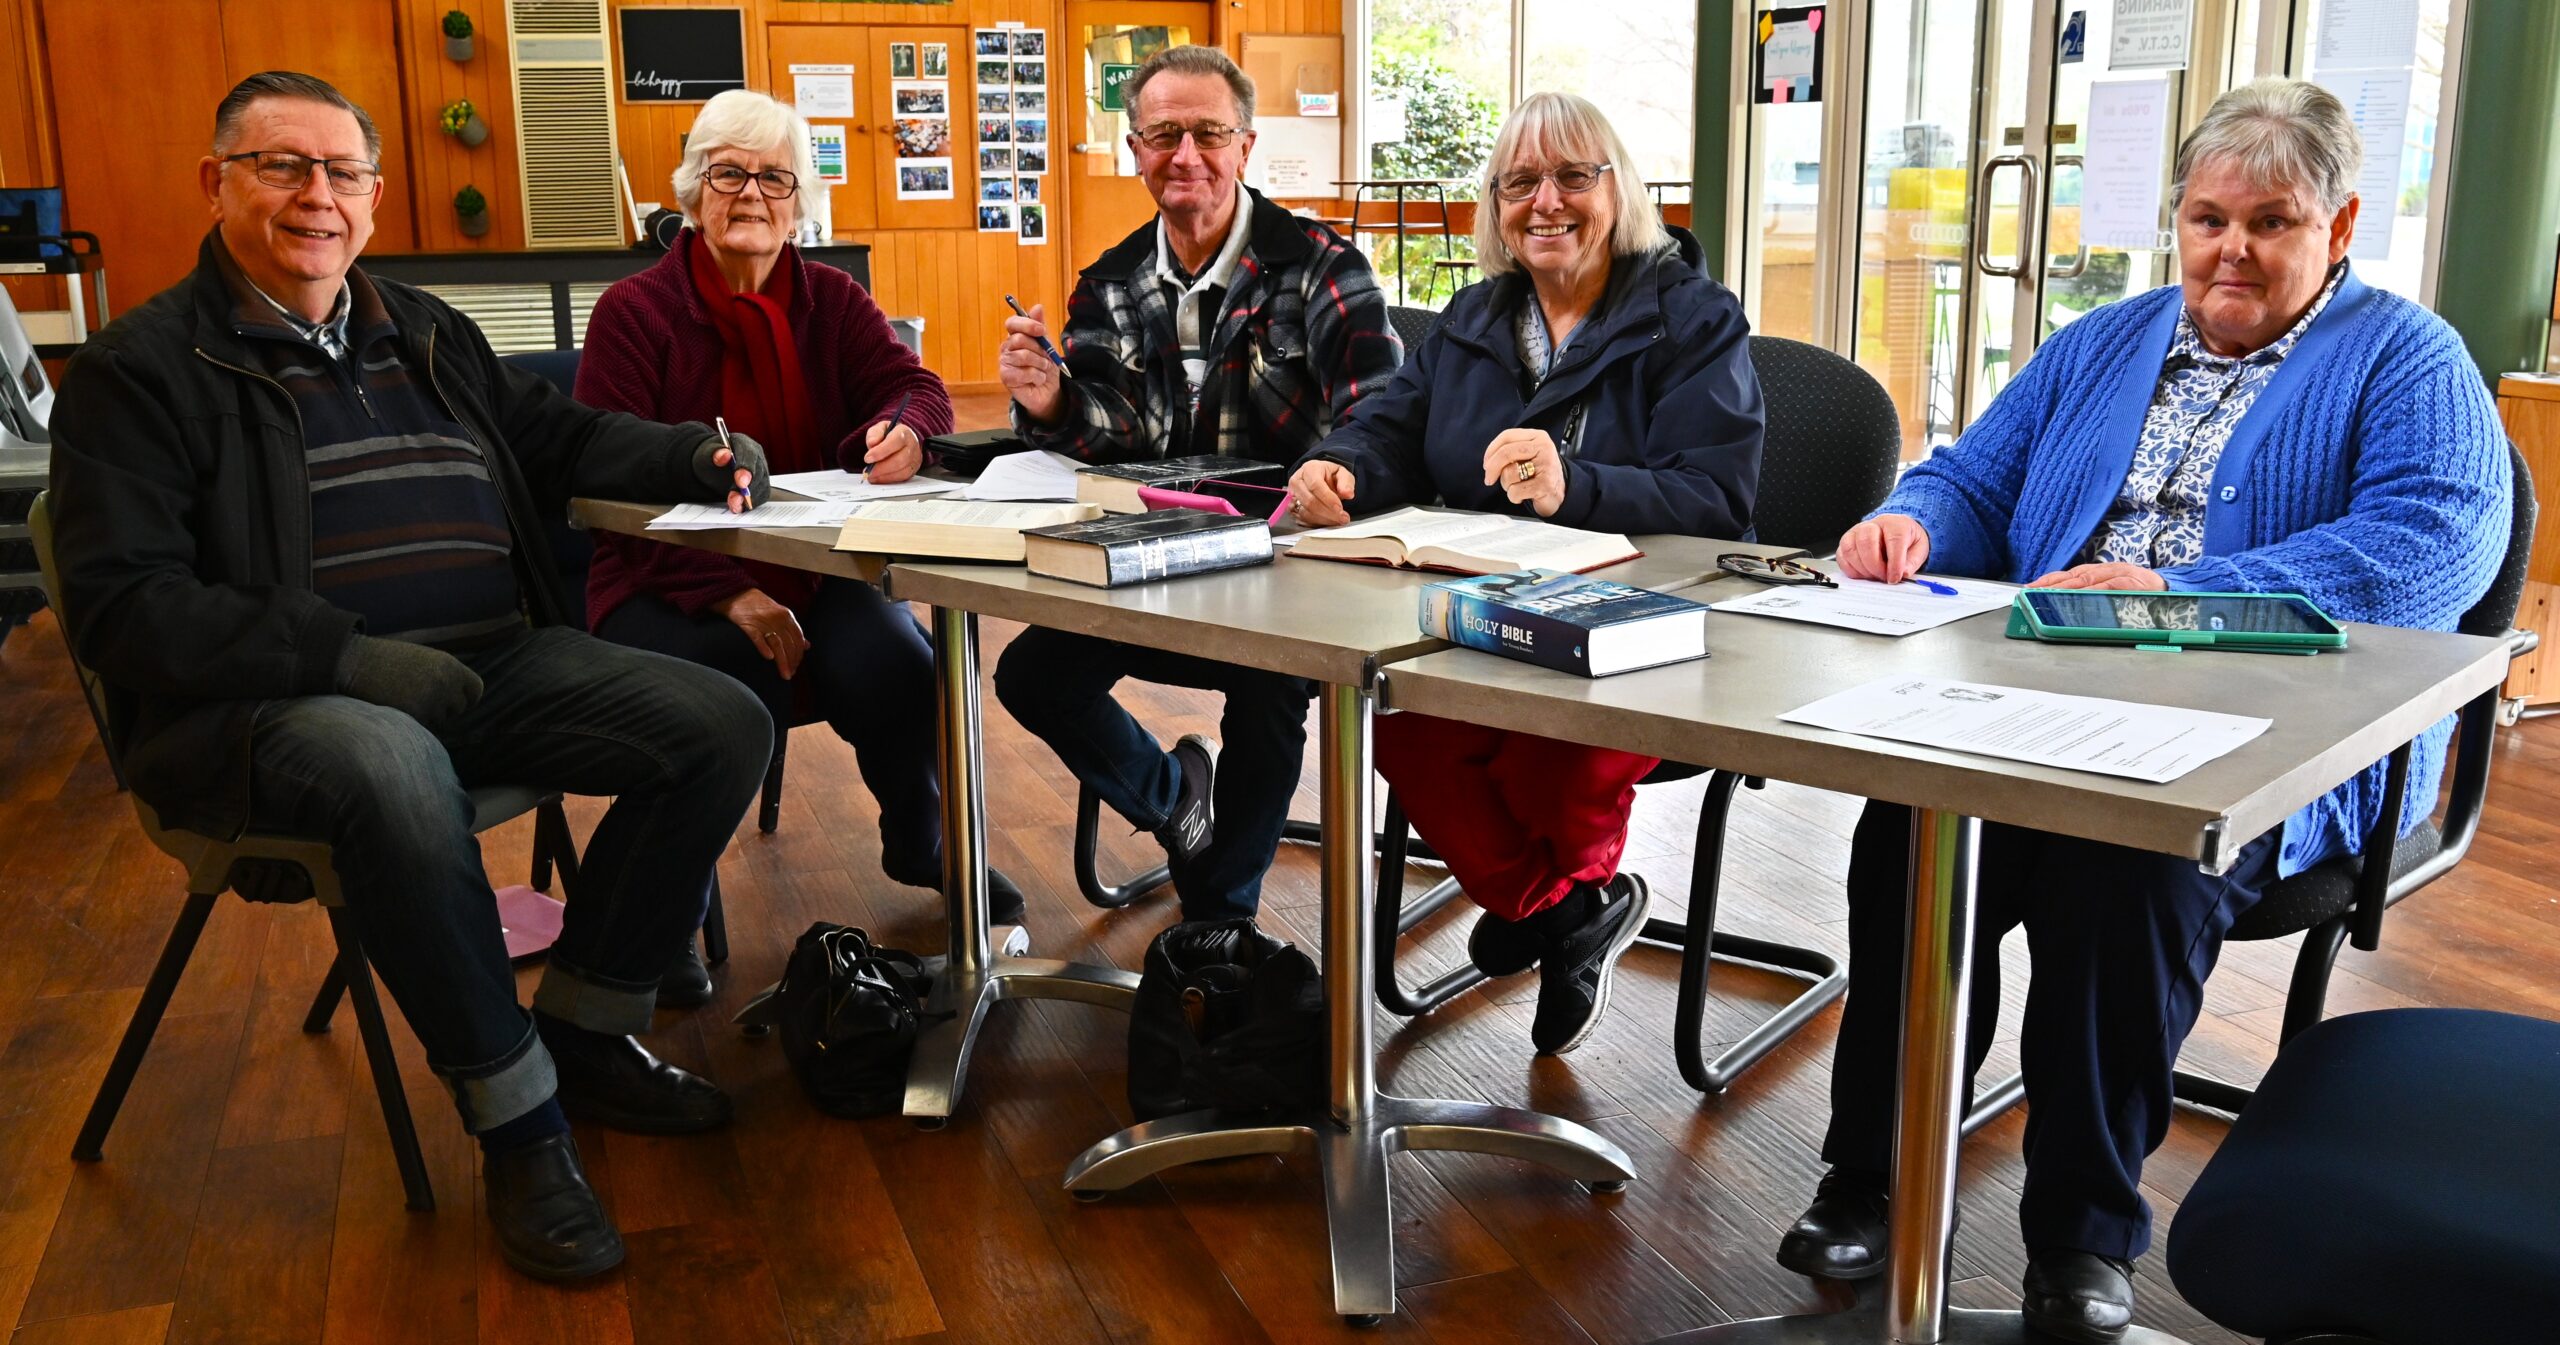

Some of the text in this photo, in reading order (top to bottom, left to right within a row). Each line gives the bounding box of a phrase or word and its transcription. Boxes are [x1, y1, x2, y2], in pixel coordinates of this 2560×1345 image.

[646, 70, 682, 98] happy
[1106, 69, 1133, 86] WAR
[1523, 585, 1649, 614] BIBLE
[1465, 615, 1533, 646] HOLY BIBLE
